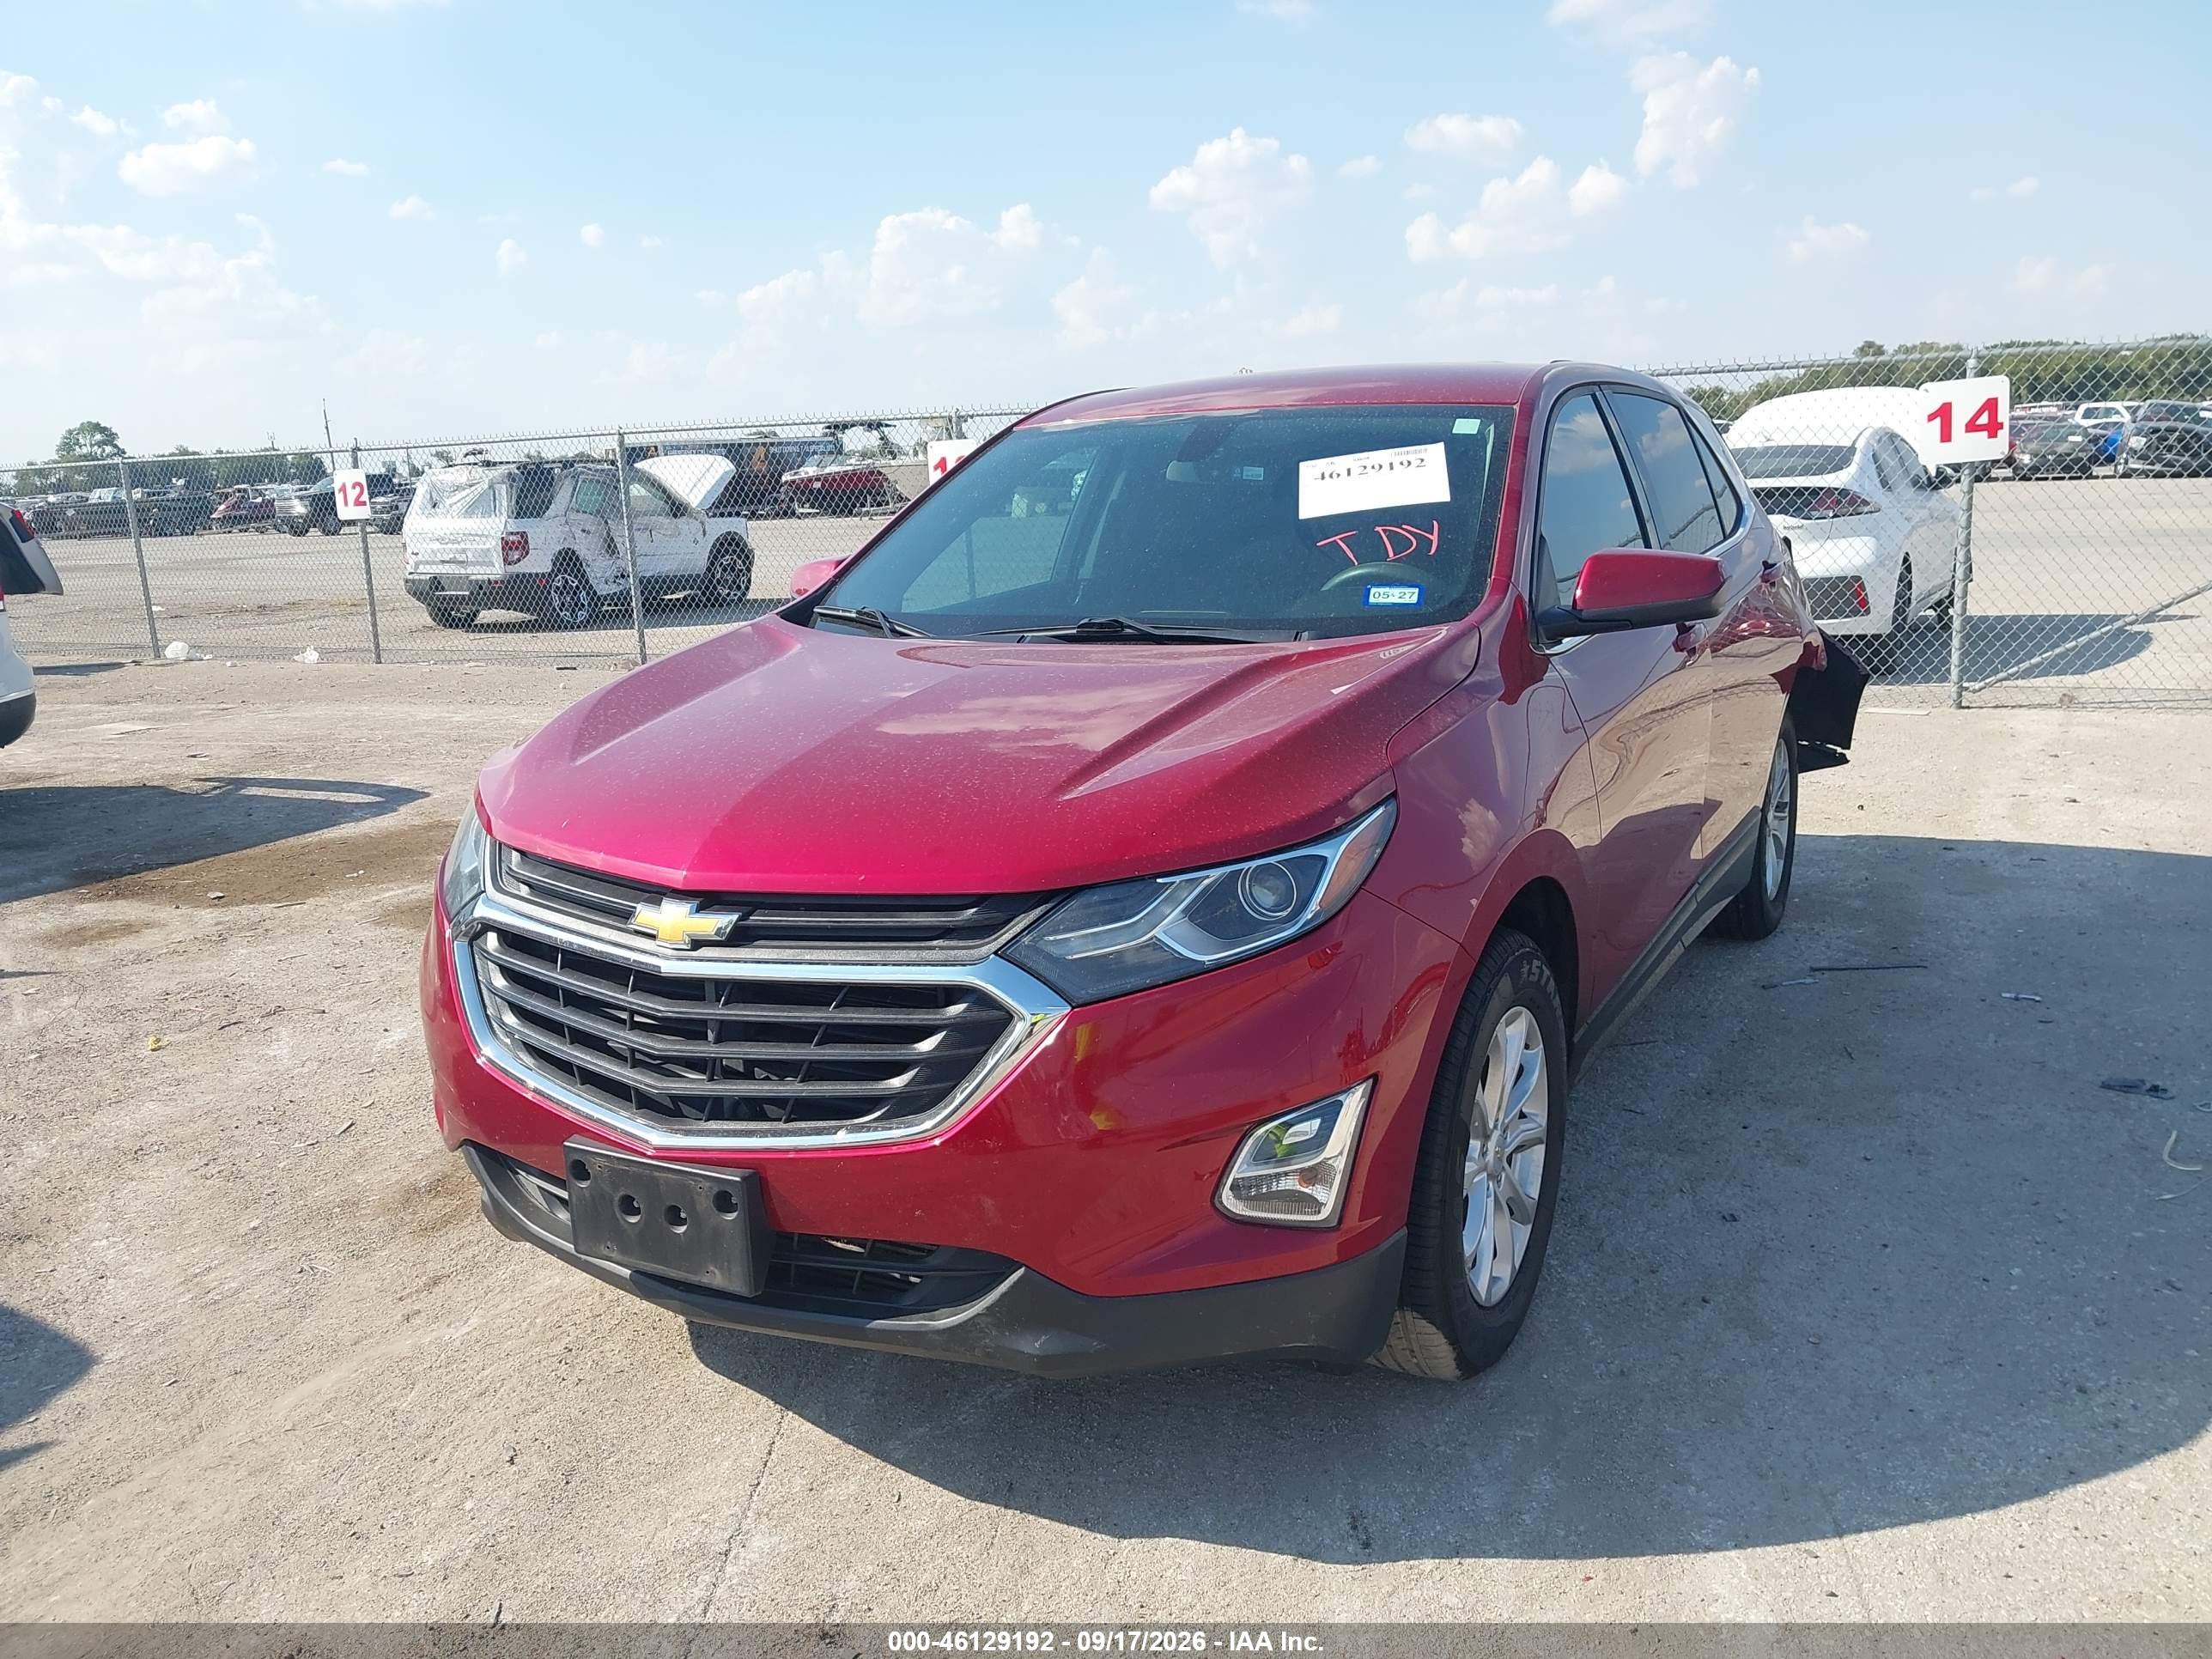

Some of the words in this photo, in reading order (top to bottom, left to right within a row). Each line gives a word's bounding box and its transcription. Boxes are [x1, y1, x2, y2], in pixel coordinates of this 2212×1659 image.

[1927, 397, 2004, 444] 14
[933, 456, 966, 476] 1
[1314, 458, 1426, 482] 46129192
[337, 481, 368, 507] 12
